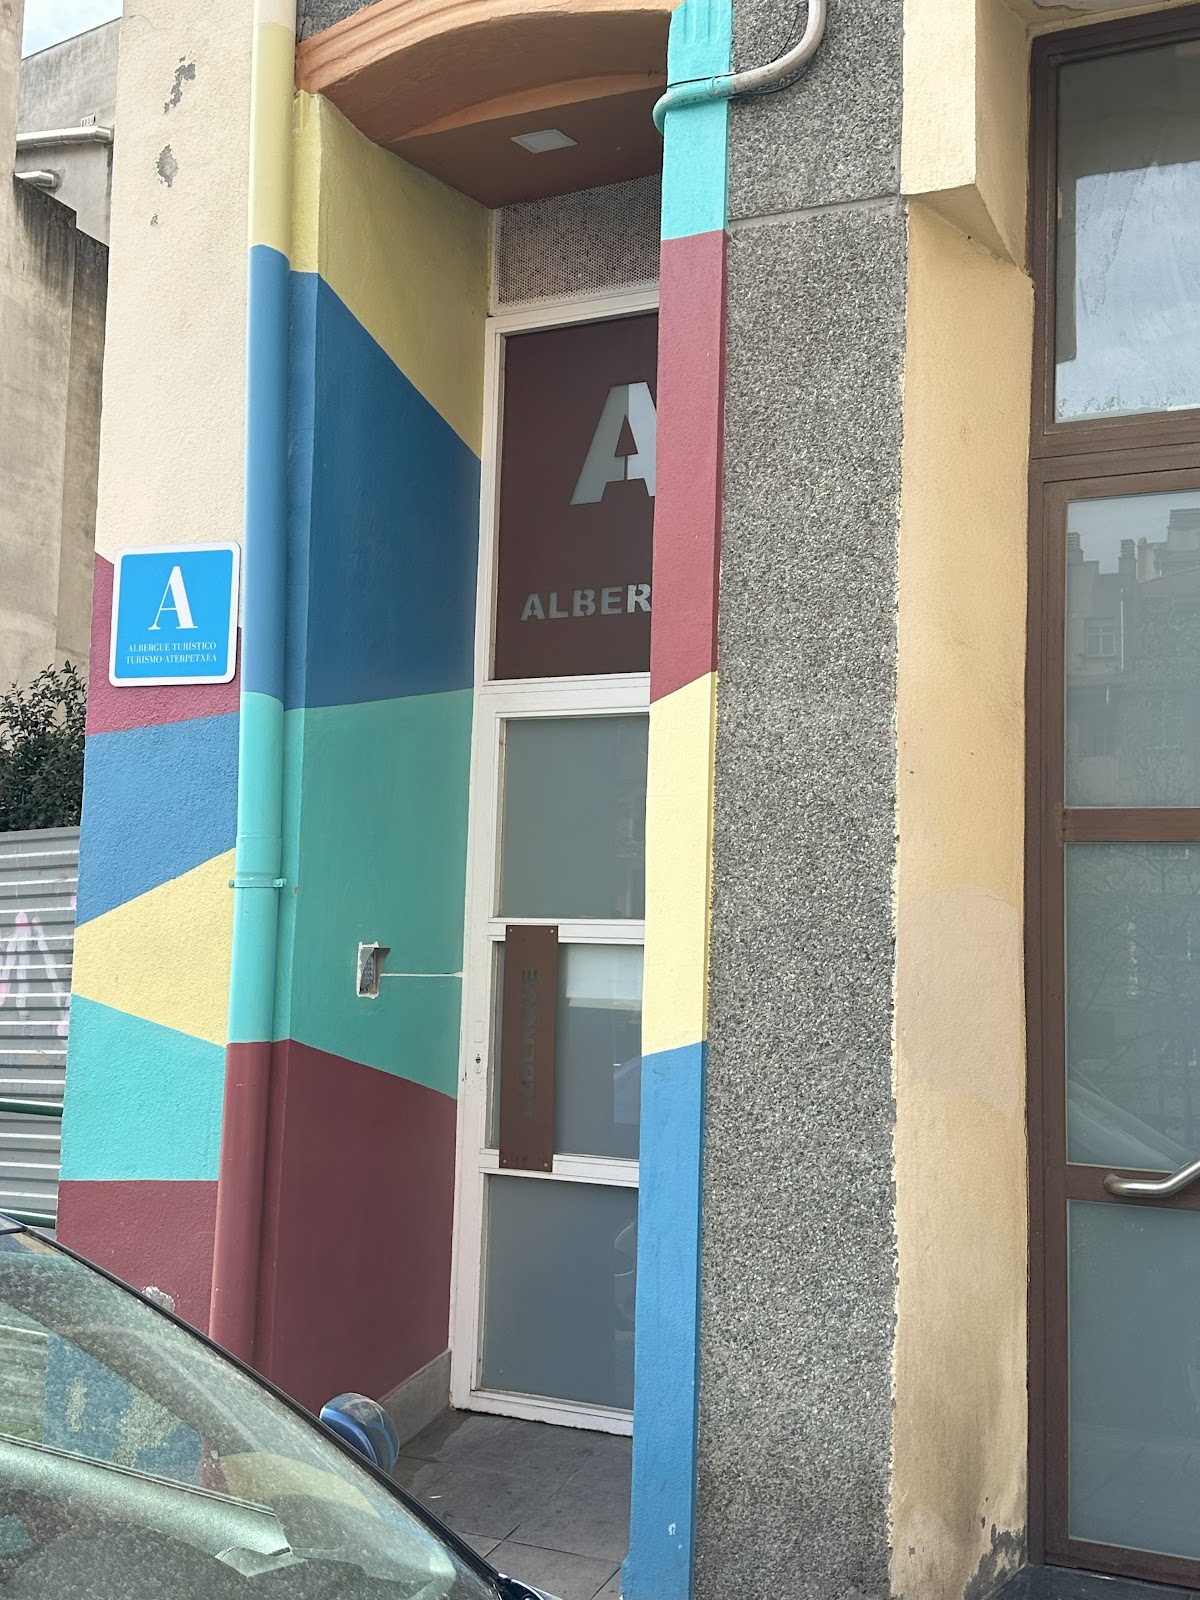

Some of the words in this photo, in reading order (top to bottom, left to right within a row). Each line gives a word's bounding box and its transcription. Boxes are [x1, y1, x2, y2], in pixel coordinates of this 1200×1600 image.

[569, 381, 656, 505] A
[148, 565, 198, 630] A
[520, 583, 652, 621] ALBER
[128, 643, 170, 653] ALBERGUE
[172, 641, 217, 651] TURÍSTICO
